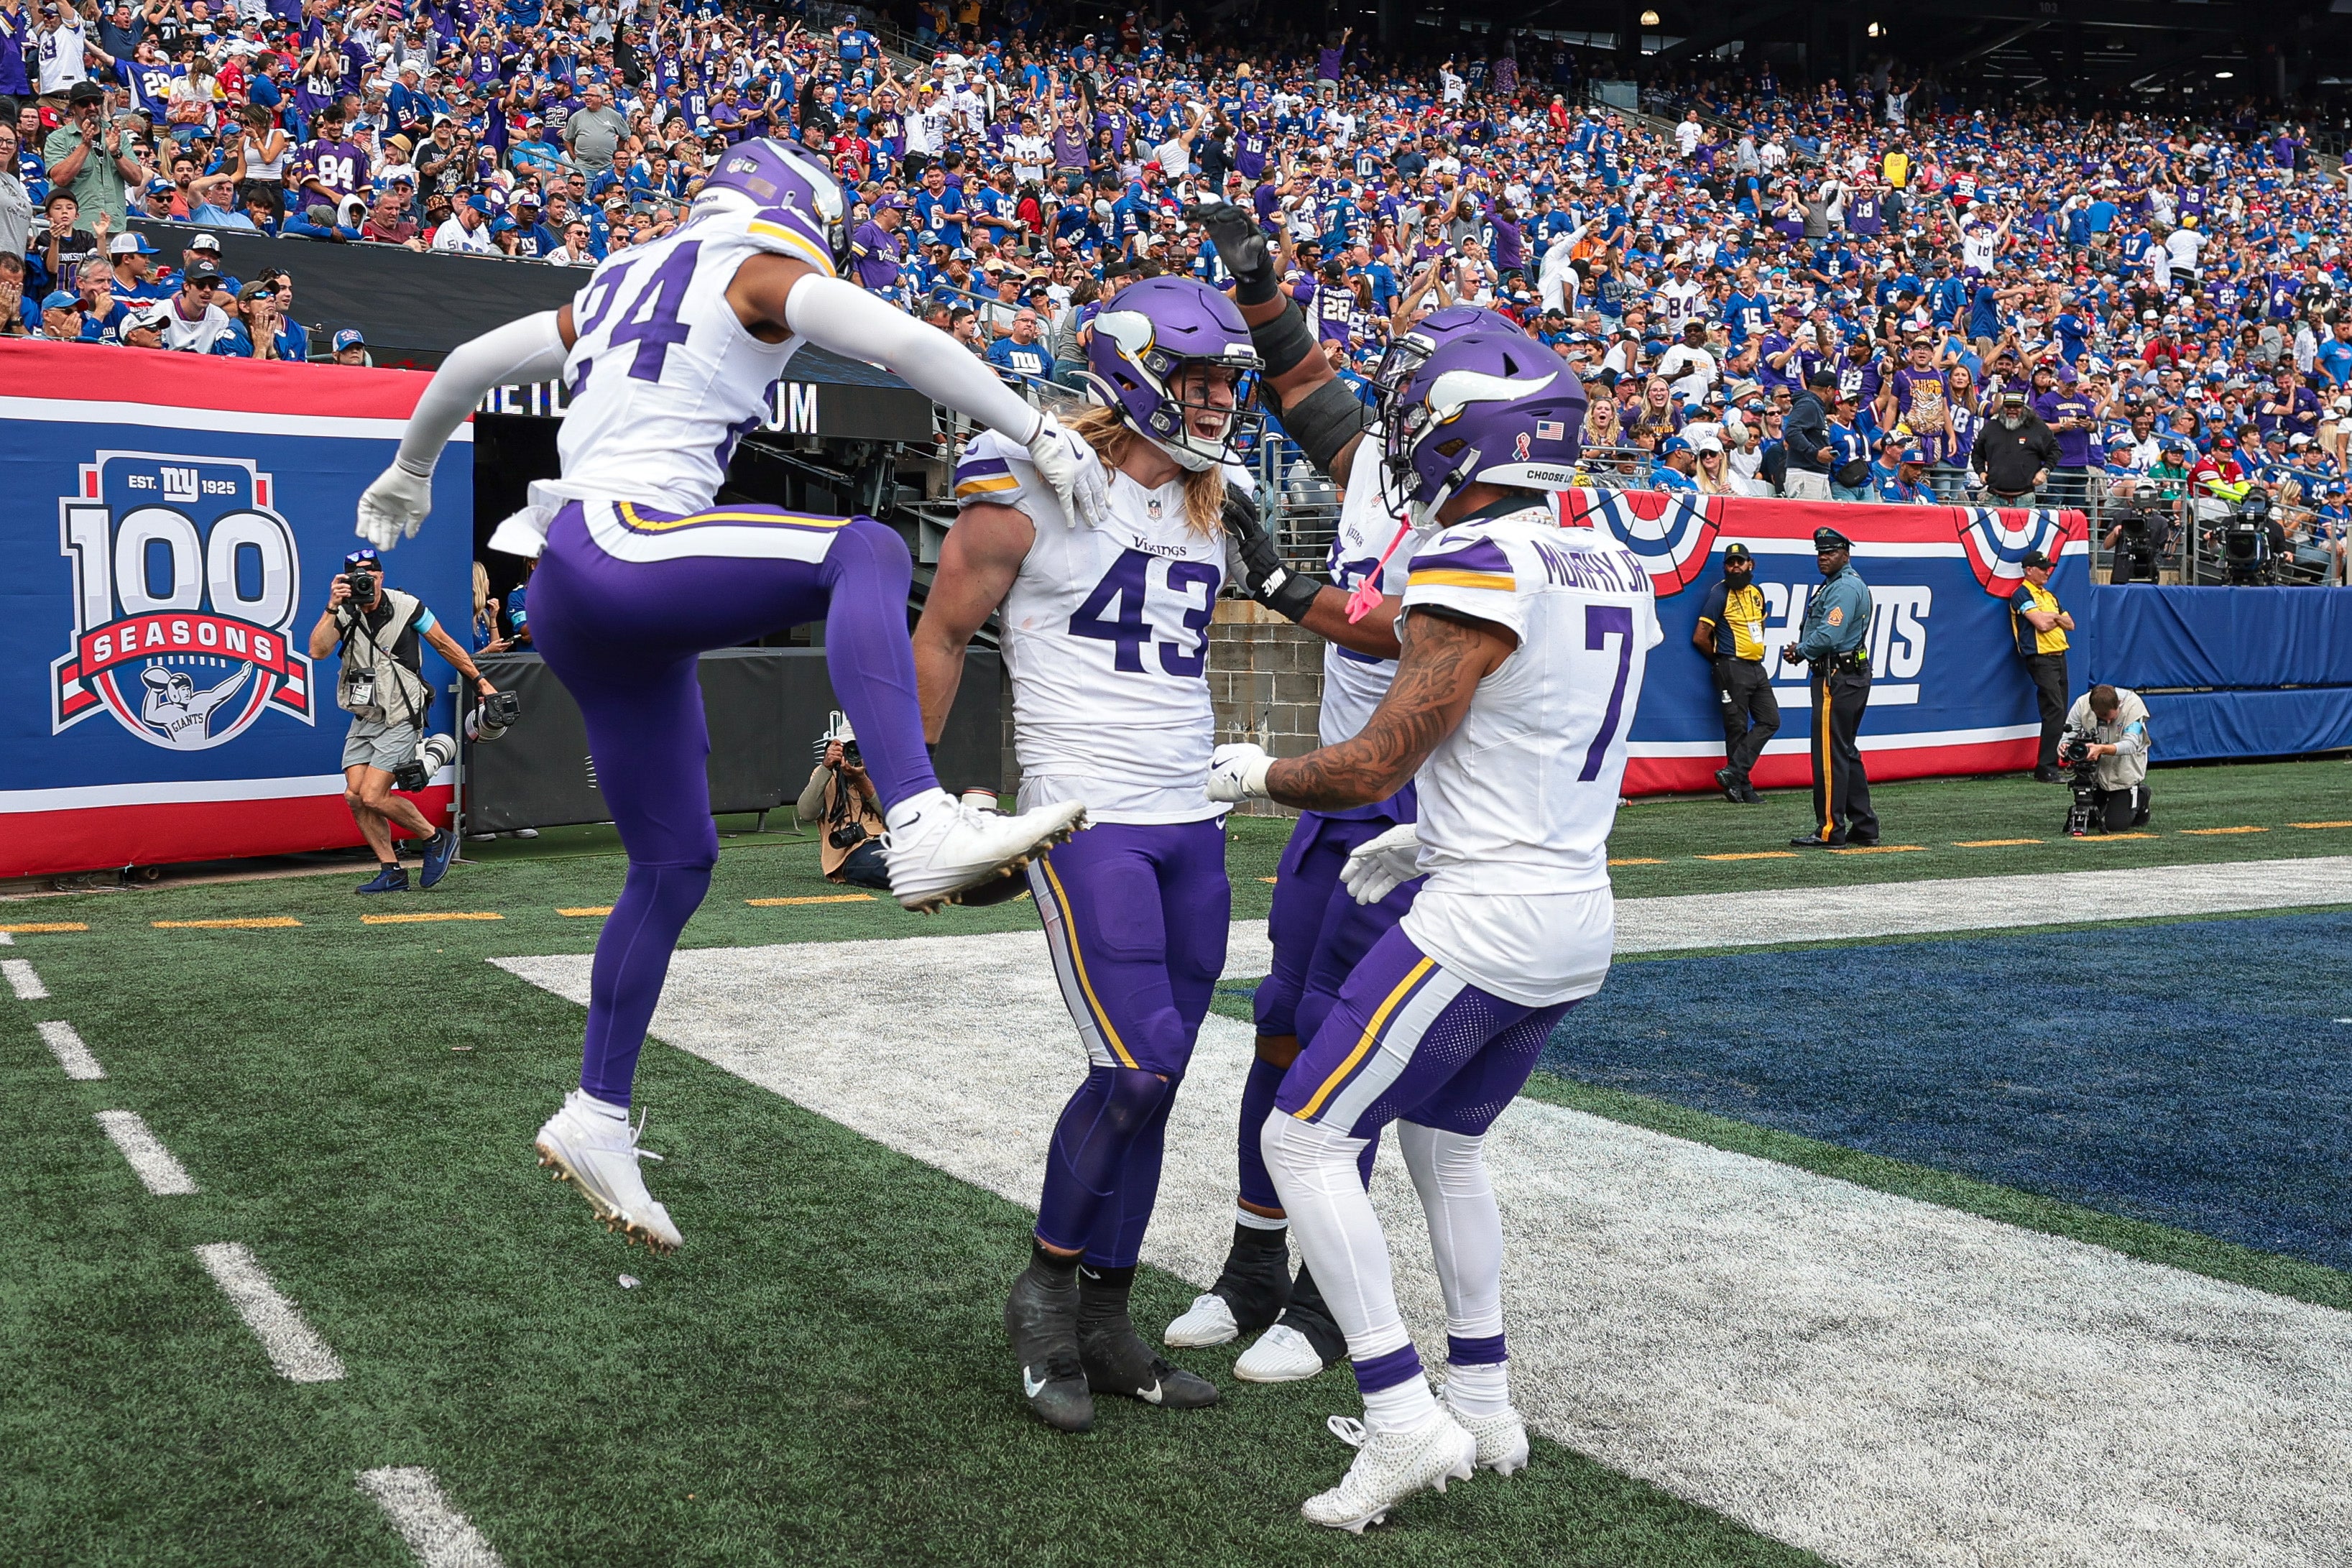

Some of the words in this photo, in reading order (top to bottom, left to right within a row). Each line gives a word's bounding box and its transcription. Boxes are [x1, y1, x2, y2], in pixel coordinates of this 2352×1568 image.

[162, 26, 177, 39] 21
[481, 57, 492, 71] 9
[1470, 68, 1482, 78] 27
[1761, 79, 1771, 91] 11
[690, 96, 705, 114] 18
[398, 110, 411, 121] 56
[545, 107, 568, 128] 22
[1112, 117, 1120, 130] 3
[1147, 124, 1162, 139] 12
[1246, 138, 1263, 153] 18
[742, 162, 756, 172] KJ
[877, 152, 887, 170] 5
[1356, 159, 1373, 175] 10
[318, 155, 354, 190] 84
[1959, 180, 1975, 196] 56
[997, 199, 1015, 220] 92
[1857, 201, 1873, 218] 18
[1123, 213, 1135, 225] 30
[1482, 229, 1492, 246] 8
[1538, 222, 1549, 240] 5
[2125, 239, 2139, 255] 17
[1934, 292, 1942, 310] 5
[2220, 290, 2234, 304] 22
[1323, 298, 1350, 322] 28
[1669, 297, 1694, 318] 84
[566, 239, 703, 397] 24
[1743, 308, 1761, 328] 15
[1010, 351, 1042, 374] ny
[129, 475, 157, 489] EST.
[161, 466, 198, 502] ny
[201, 479, 236, 495] 1925
[1526, 469, 1564, 483] CHOOSE
[1132, 534, 1187, 557] Vikings
[68, 505, 296, 627] 100
[1261, 567, 1287, 597] NIKE
[1069, 547, 1222, 678] 43
[93, 619, 272, 663] SEASONS
[1577, 605, 1633, 782] 7
[172, 712, 204, 733] GIANTS
